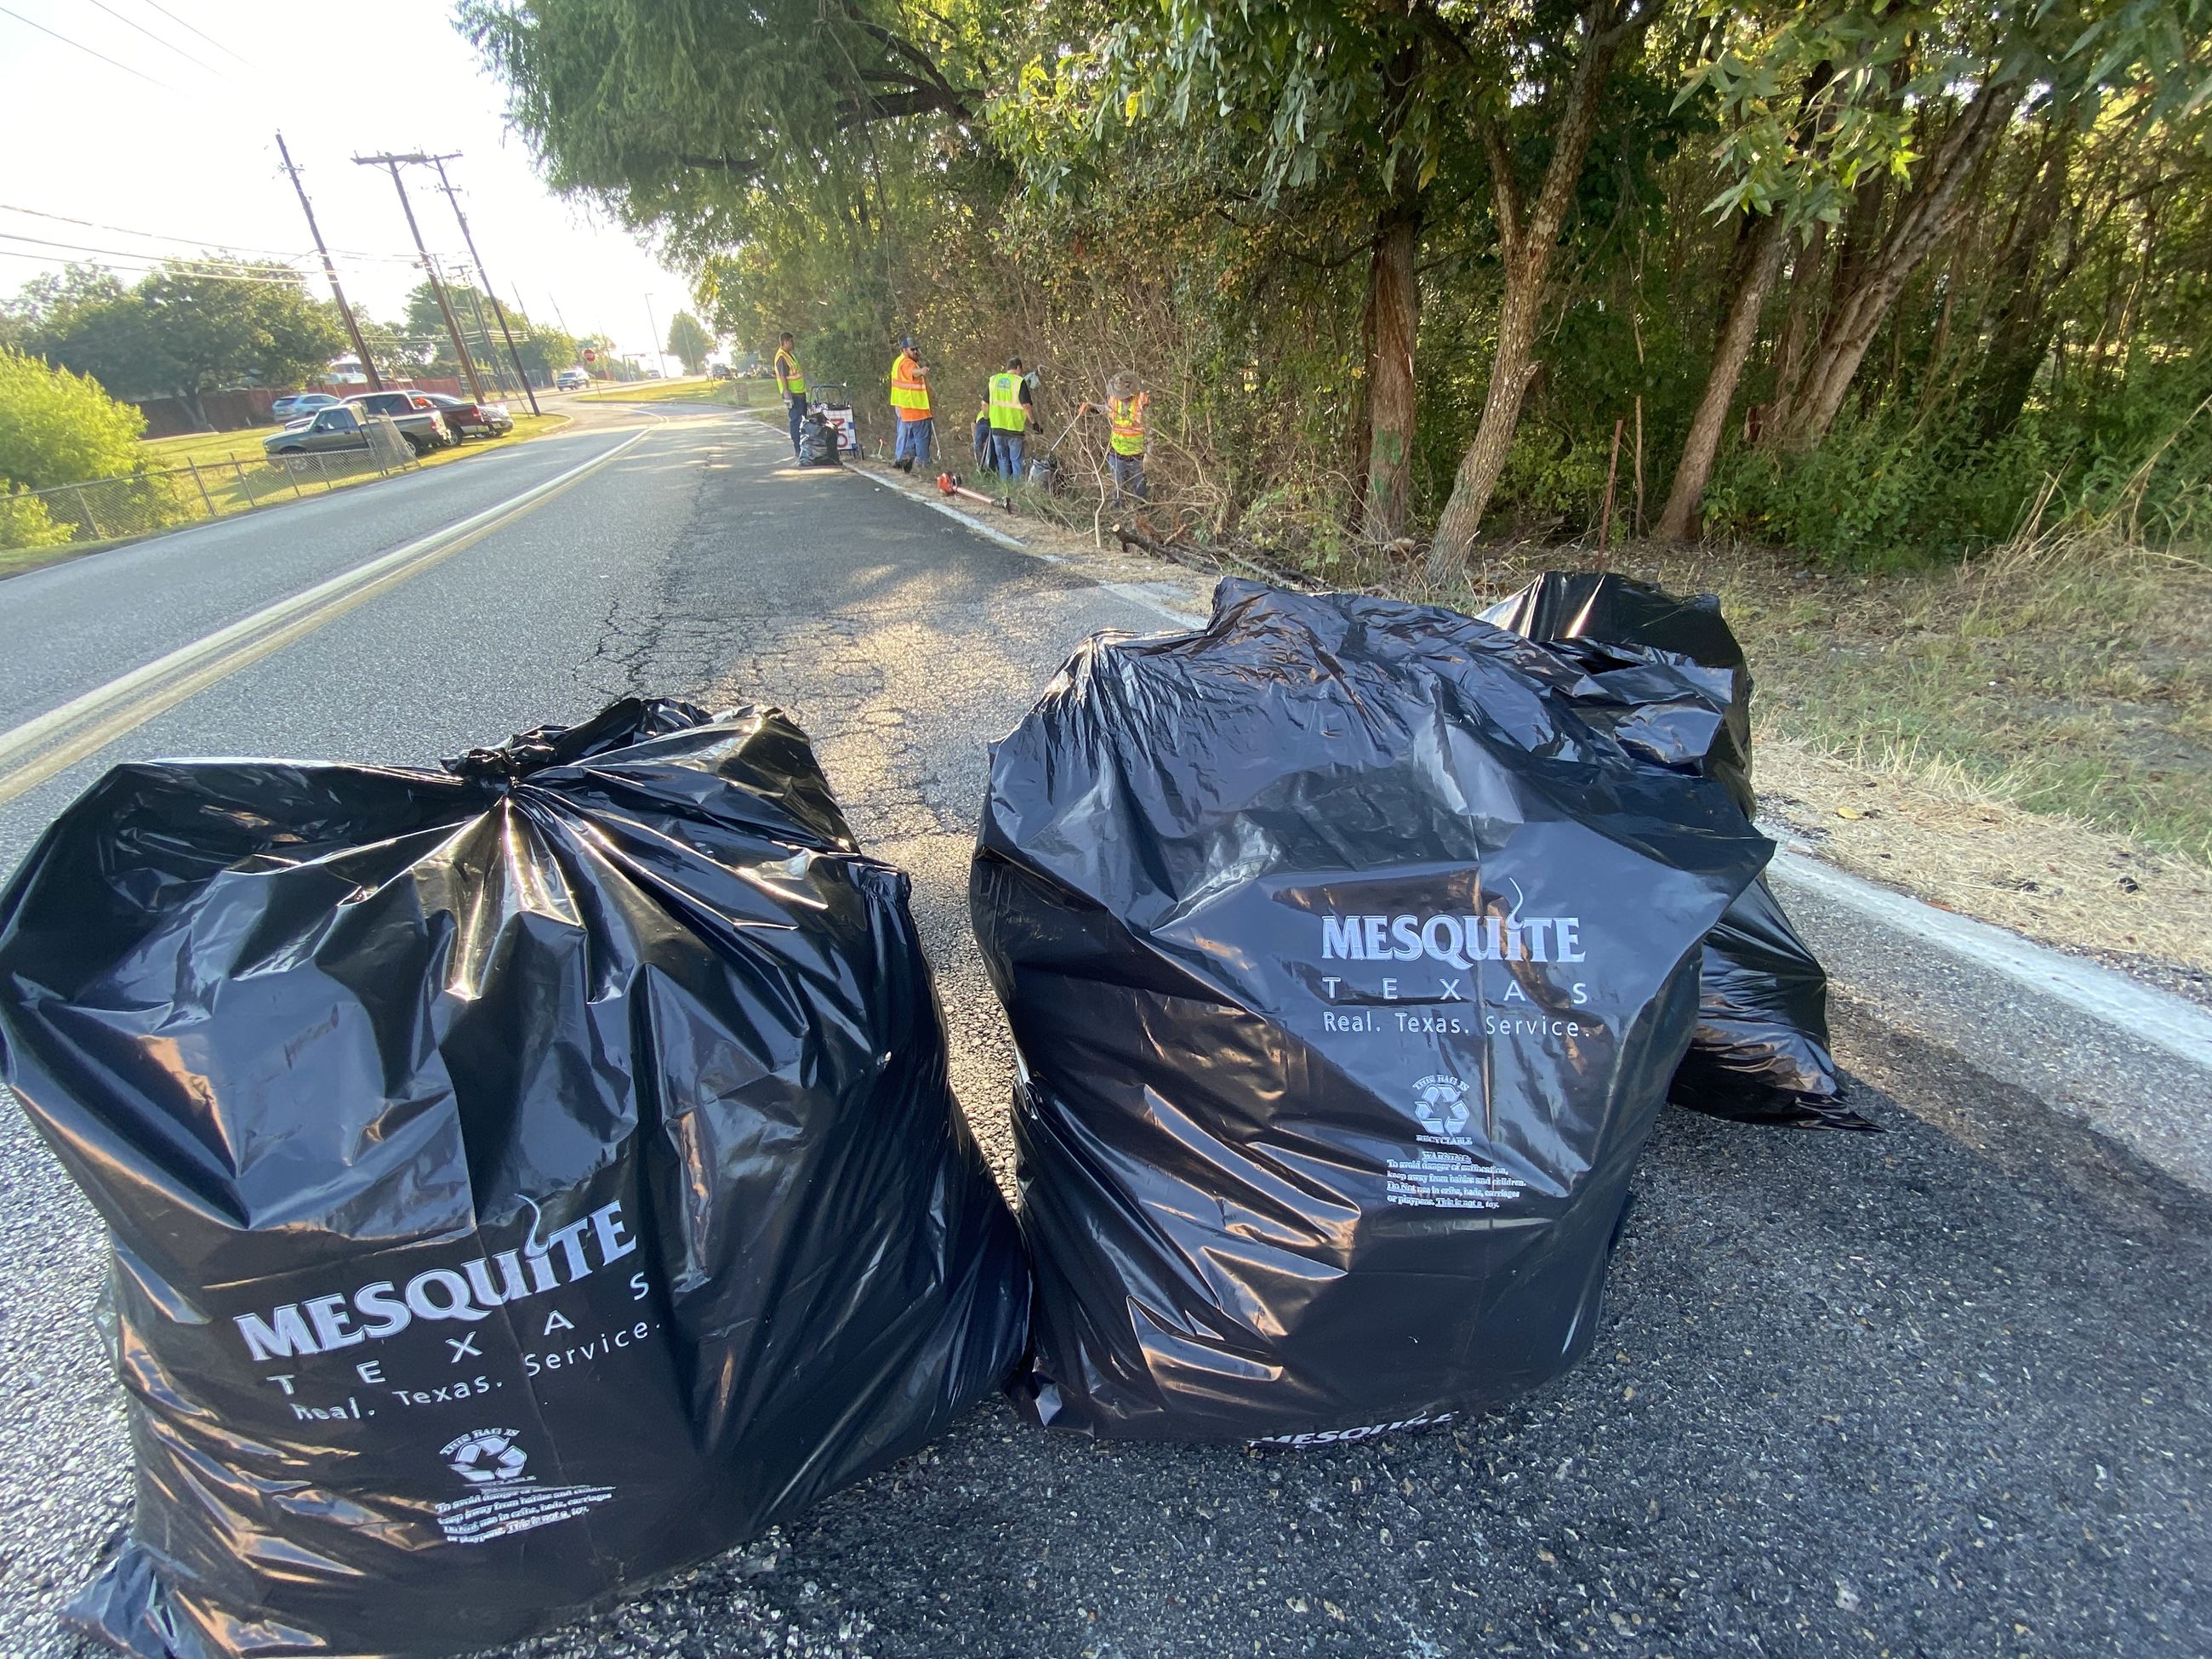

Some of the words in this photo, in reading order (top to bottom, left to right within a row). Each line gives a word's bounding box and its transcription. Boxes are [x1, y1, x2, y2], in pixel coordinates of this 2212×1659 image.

[1322, 1010, 1382, 1033] Real.
[1394, 1012, 1470, 1035] Texas.
[1485, 1015, 1592, 1038] Service.
[1412, 1075, 1436, 1090] THIS
[1436, 1074, 1458, 1086] BAG
[1457, 1080, 1470, 1092] IS
[1415, 1134, 1473, 1146] RECYCLABLE
[1386, 1159, 1399, 1168] To
[1399, 1160, 1421, 1170] avoid
[1421, 1160, 1451, 1172] danger
[1451, 1162, 1462, 1172] of
[1386, 1170, 1407, 1181] keep
[1406, 1174, 1428, 1183] away
[1428, 1172, 1449, 1183] from
[1449, 1174, 1474, 1184] babies
[1475, 1176, 1491, 1185] and
[1386, 1194, 1398, 1203] or
[1431, 1185, 1440, 1194] in
[1484, 1189, 1520, 1200] carriages
[289, 1396, 376, 1422] Real.
[392, 1374, 505, 1407] Texas.
[524, 1320, 663, 1378] Service.
[503, 1428, 521, 1437] IS
